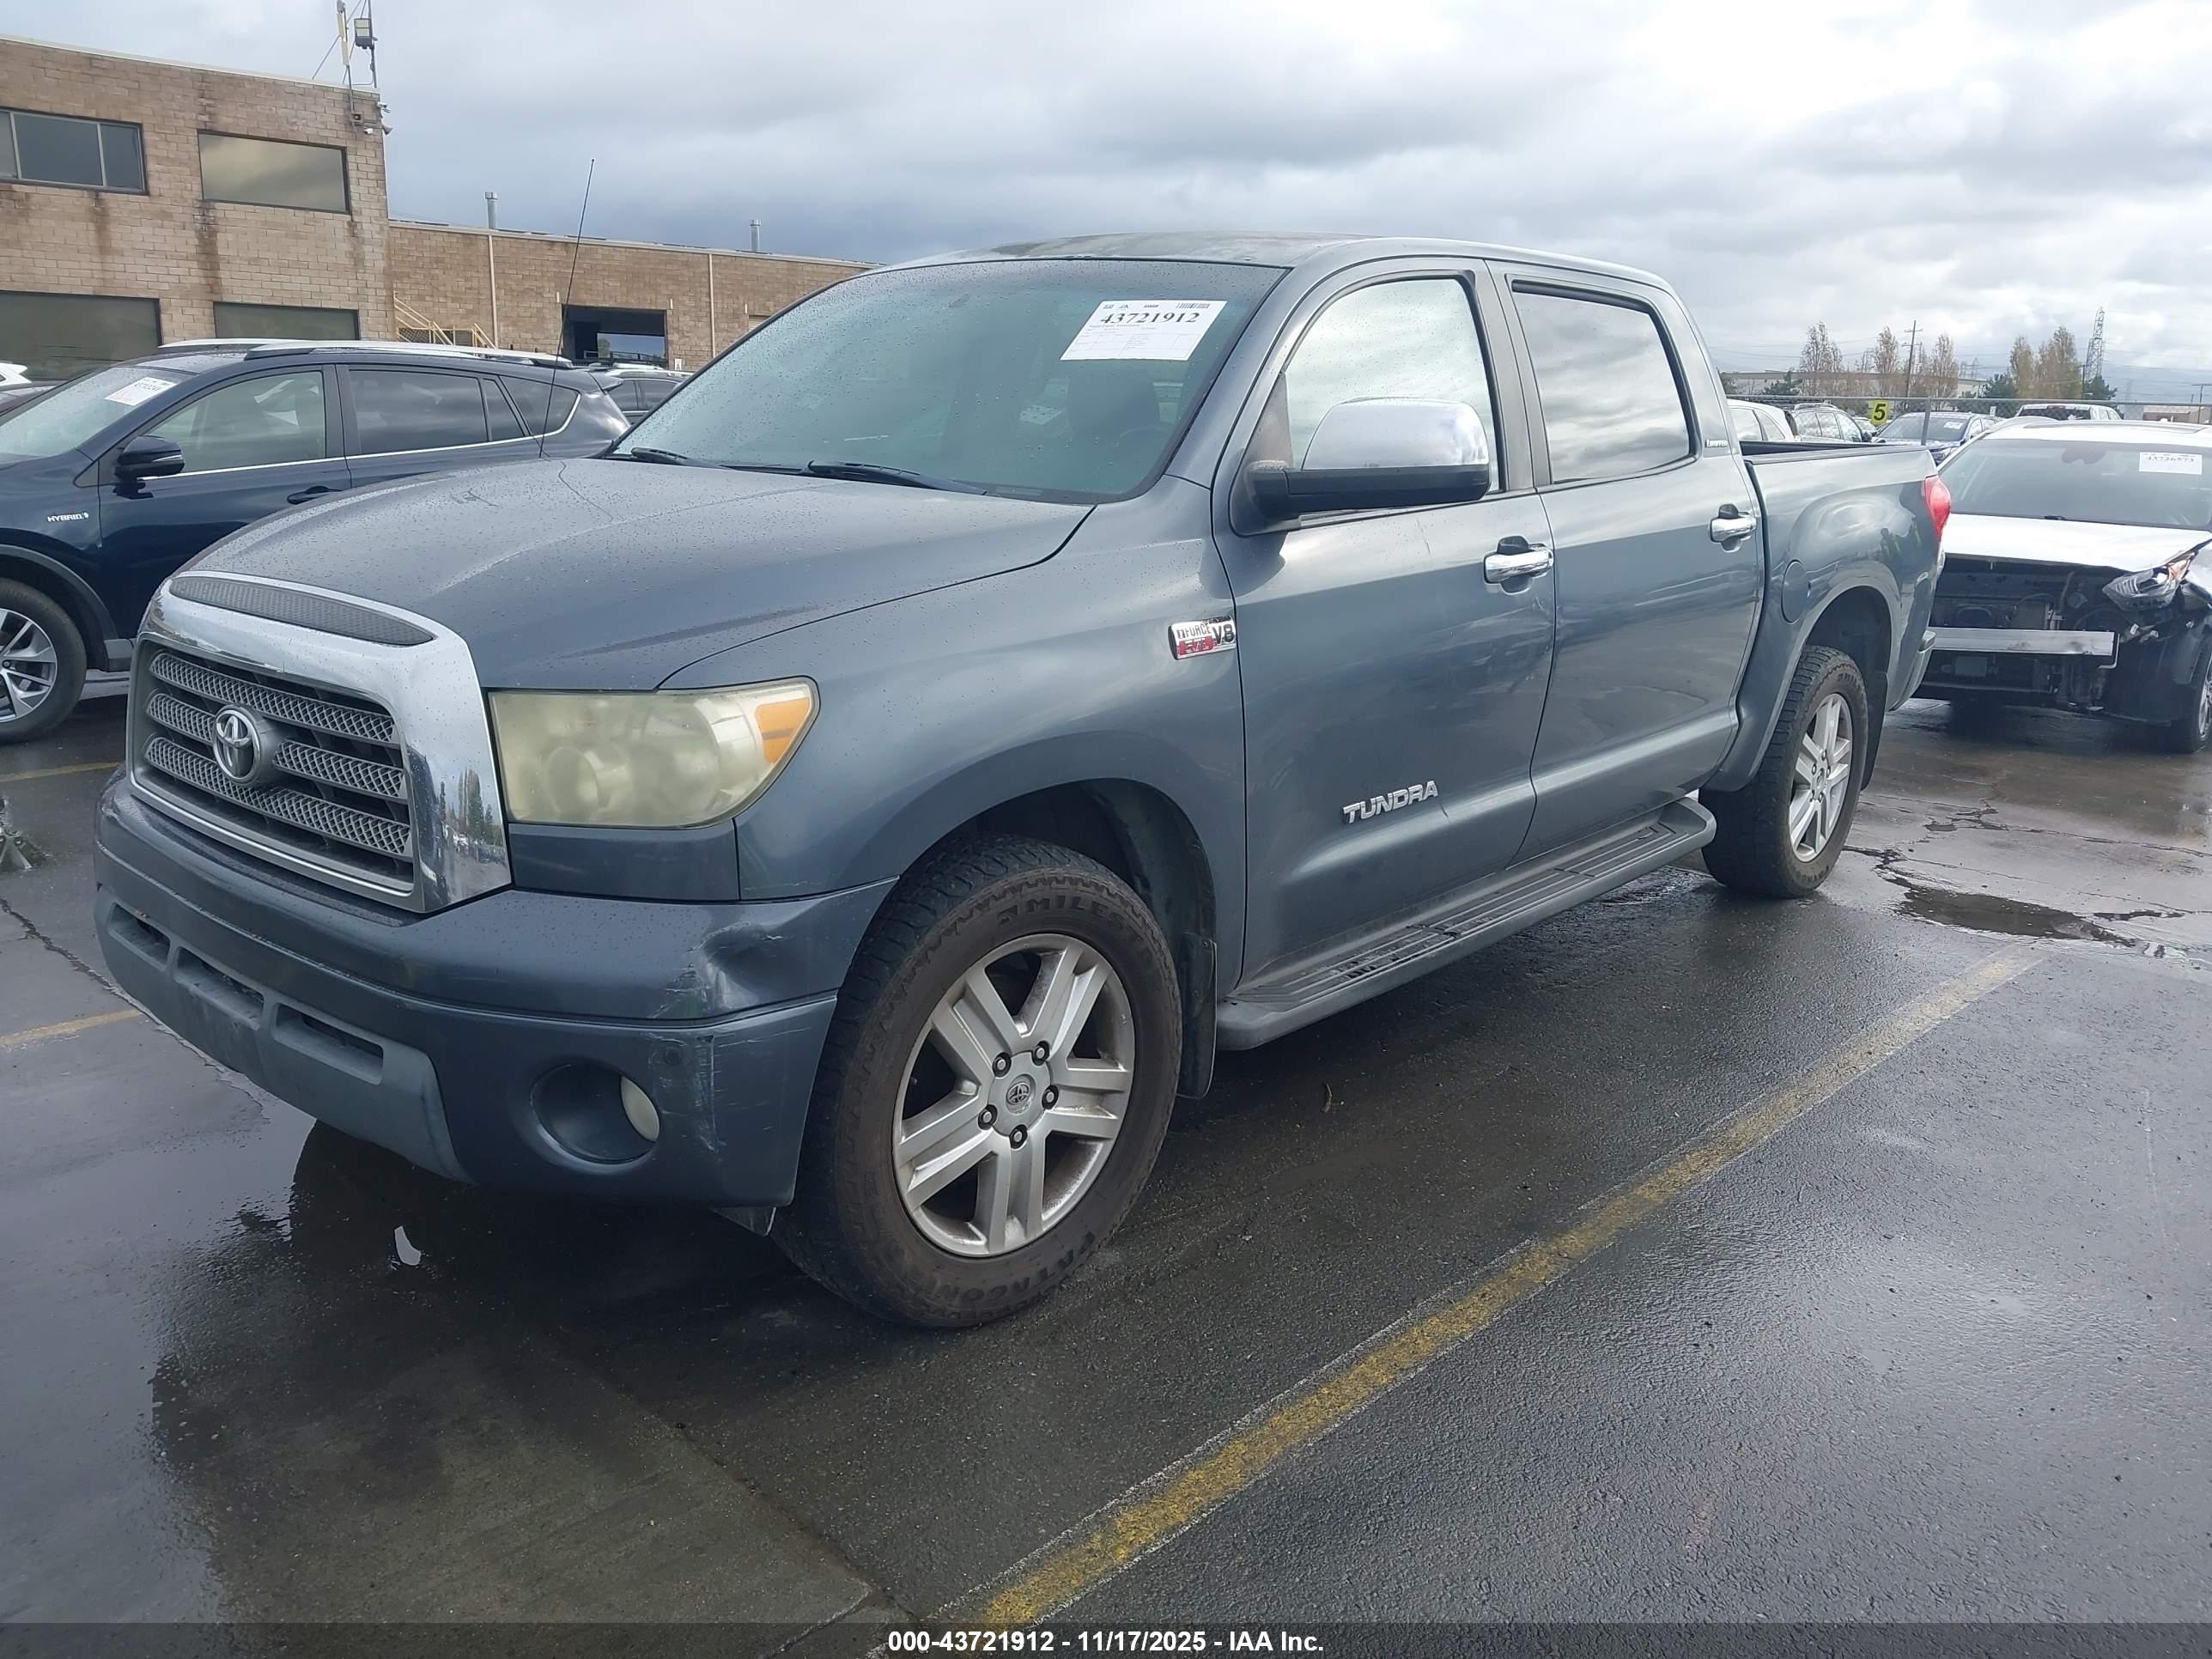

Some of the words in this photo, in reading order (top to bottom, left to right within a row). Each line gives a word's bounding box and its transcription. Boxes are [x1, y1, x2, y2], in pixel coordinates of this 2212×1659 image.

[1100, 312, 1200, 324] 43721912
[1873, 403, 1887, 421] 5
[47, 513, 83, 522] HYBRID
[1212, 623, 1235, 644] V8
[1342, 780, 1439, 823] TUNDRA
